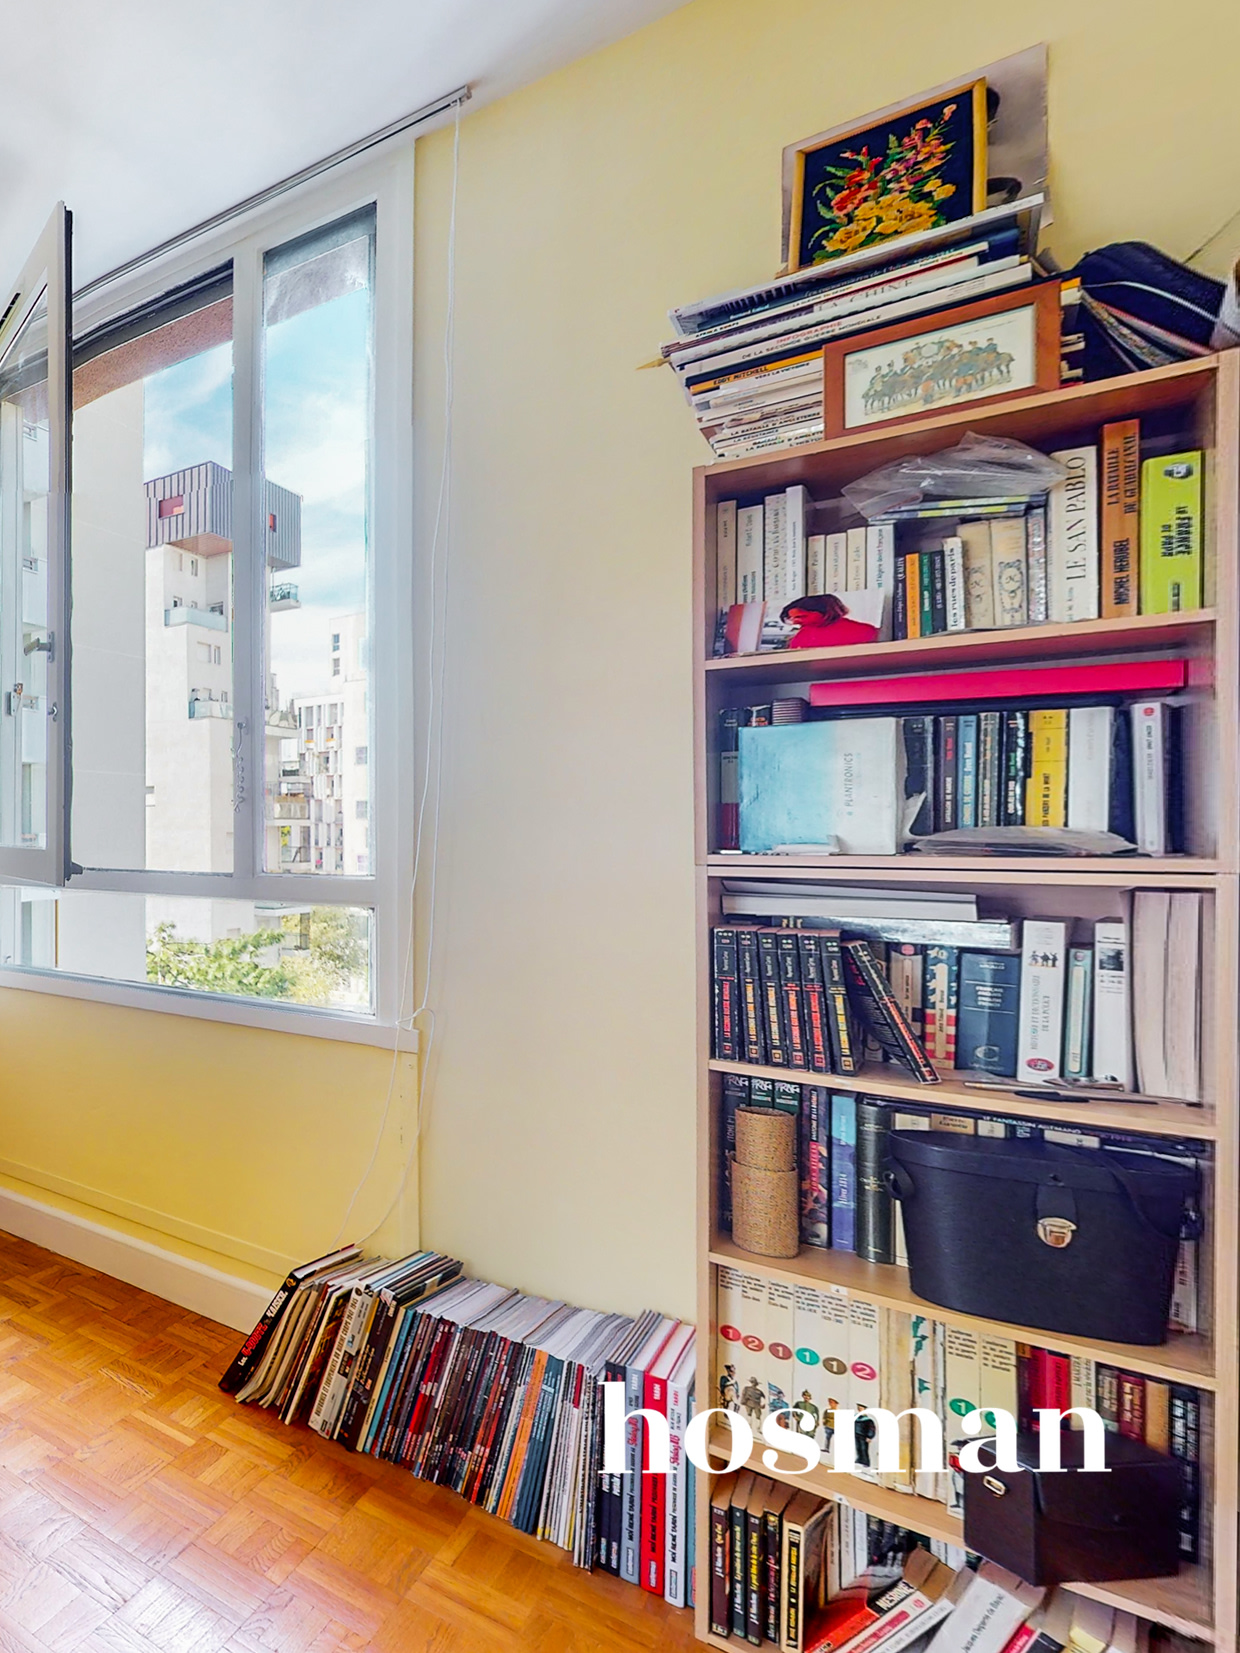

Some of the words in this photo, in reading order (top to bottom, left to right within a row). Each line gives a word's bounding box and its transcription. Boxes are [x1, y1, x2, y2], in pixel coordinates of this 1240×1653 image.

[848, 277, 914, 304] CHINE
[765, 337, 801, 352] SECONDE
[802, 328, 836, 341] GUERRE
[837, 314, 882, 331] MONDIALE
[775, 320, 842, 344] INFOGRAPHIE
[712, 375, 730, 385] EDDY
[732, 365, 769, 379] MITCHELL
[780, 362, 810, 372] VICTOIRE
[740, 424, 769, 433] BATAILLE
[1106, 447, 1120, 490] BATAILLE
[1121, 432, 1138, 497] GUADALCANAL
[1063, 456, 1087, 512] PABLO
[1106, 491, 1120, 505] LA
[1123, 499, 1136, 514] DE
[1064, 519, 1086, 552] SAN
[1175, 516, 1192, 555] FRANCE
[1161, 535, 1172, 557] PAPA
[947, 547, 958, 575] paris
[1064, 556, 1086, 580] LE
[948, 587, 957, 610] rues
[1112, 574, 1130, 605] MICHEL
[841, 752, 855, 806] PLANTRONICS
[992, 1116, 1036, 1128] FANTASSIN
[810, 1143, 818, 1170] KEEGAN
[340, 1320, 351, 1336] CORPS
[727, 1329, 733, 1338] 1
[747, 1338, 760, 1349] 2
[777, 1346, 784, 1356] 1
[803, 1352, 810, 1362] 1
[830, 1361, 838, 1372] 1
[629, 1373, 639, 1390] TARDI
[856, 1366, 871, 1378] 2
[651, 1382, 661, 1400] TARDI
[957, 1402, 968, 1414] 1
